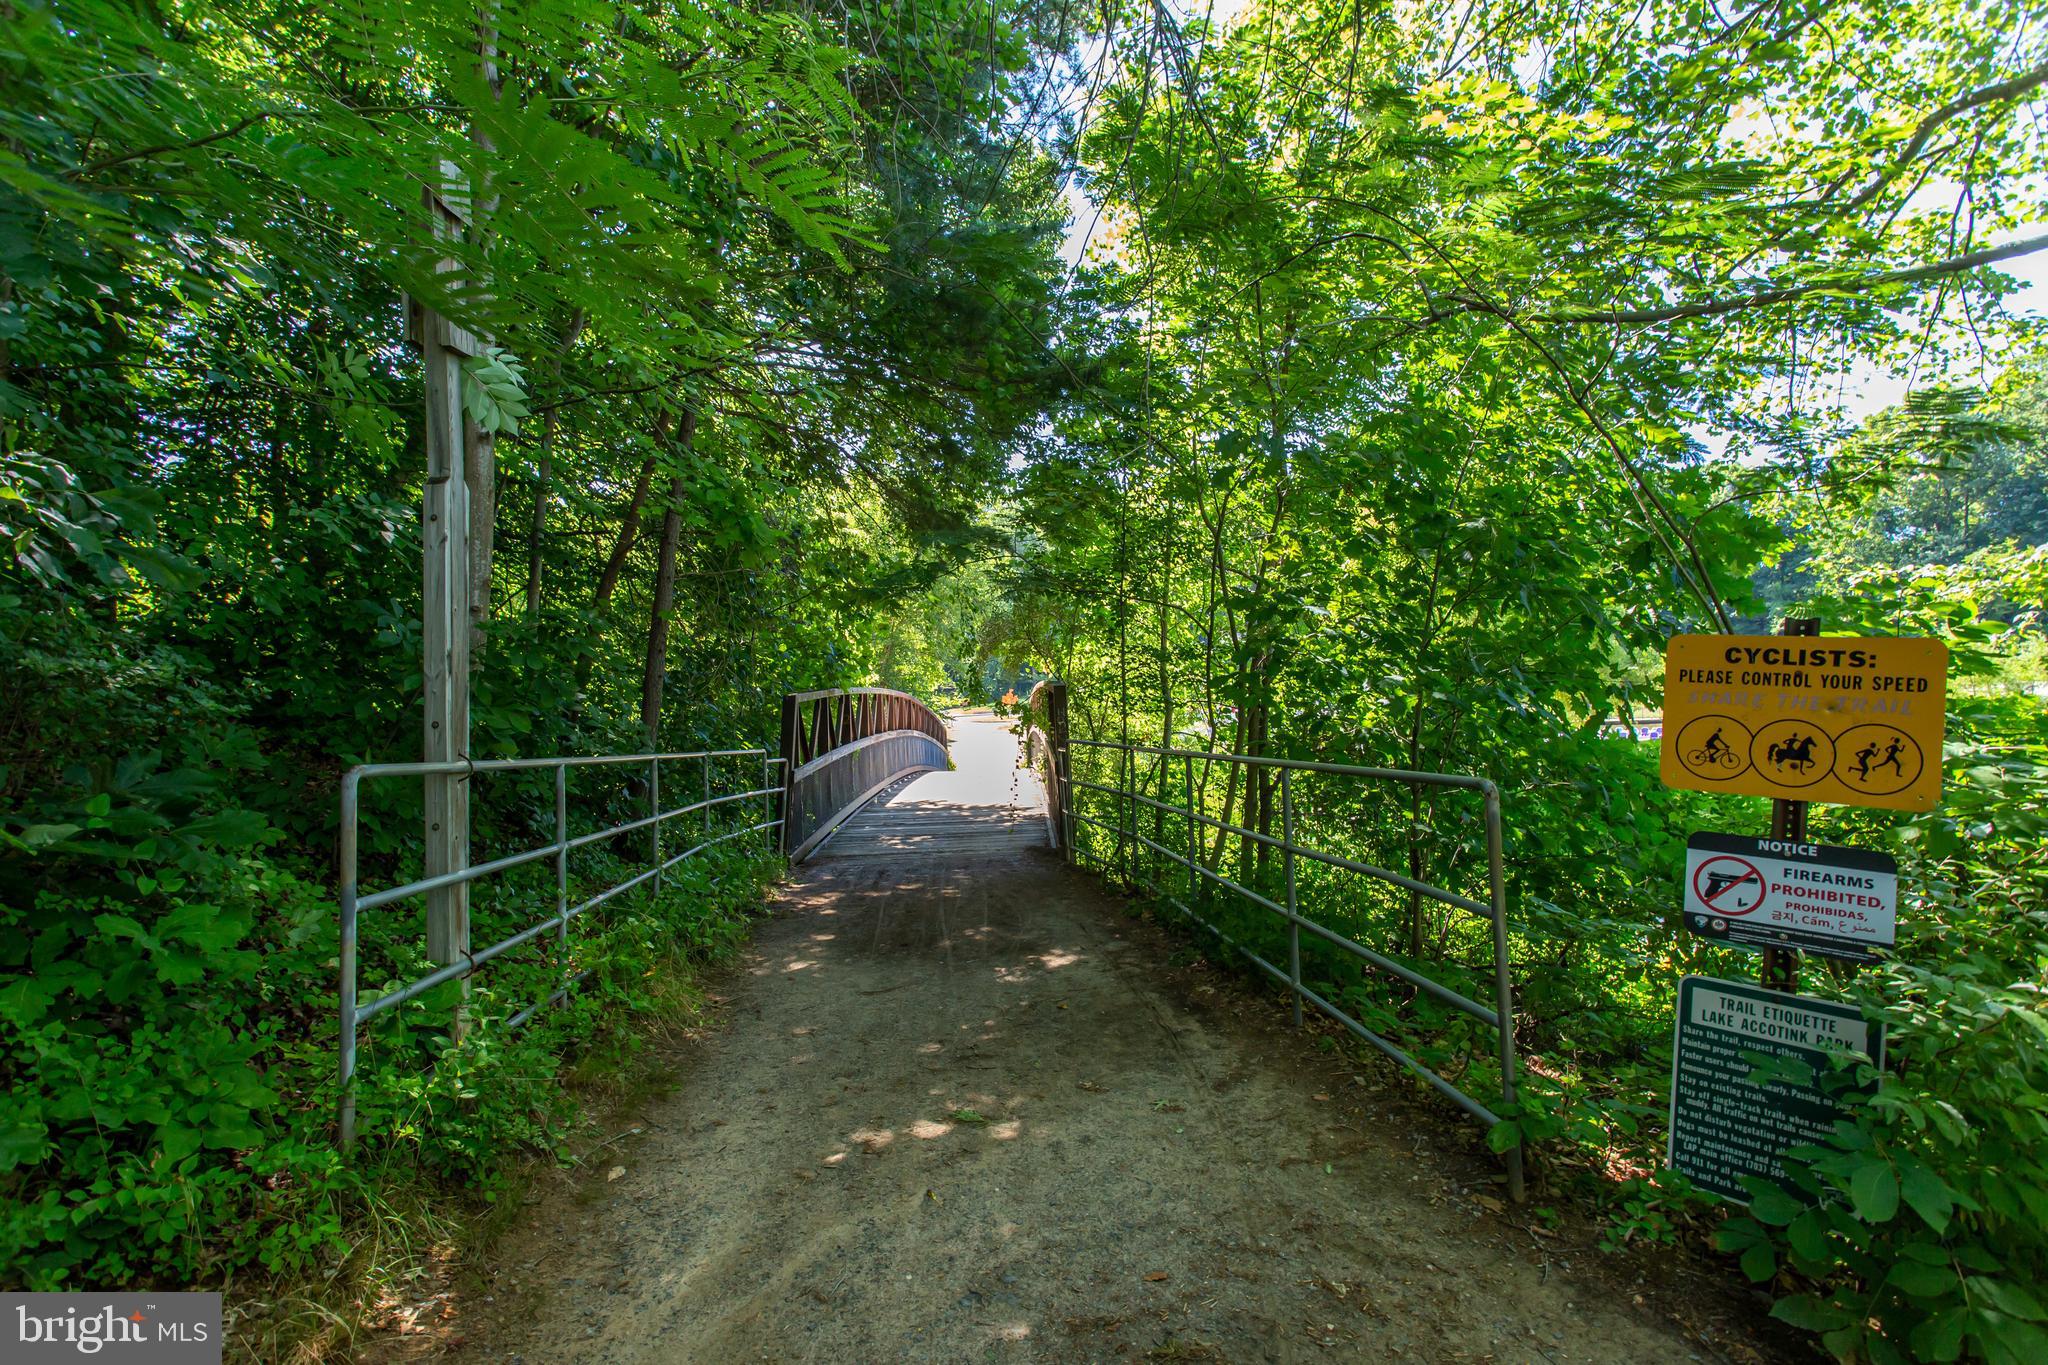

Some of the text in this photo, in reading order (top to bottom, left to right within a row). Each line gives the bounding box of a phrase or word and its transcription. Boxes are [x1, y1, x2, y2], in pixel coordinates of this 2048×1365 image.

[1725, 647, 1877, 668] CYCLISTS:
[1679, 669, 1928, 692] PLEASE CONTROL YOUR SPEED
[1687, 690, 1913, 716] SHARE THE TRAIL
[1758, 839, 1818, 857] NOTICE
[1784, 867, 1874, 889] FIREARMS
[1771, 883, 1886, 911] PROHIBITED,
[1785, 902, 1868, 921] PROHIBIDAS,
[1702, 1009, 1734, 1027] LAKE
[1741, 1018, 1808, 1044] ACCOTINK
[1720, 997, 1836, 1033] TRAIL ETIQUETTE
[1682, 1024, 1703, 1036] Share
[1706, 1031, 1718, 1040] the
[1744, 1040, 1773, 1053] respect
[1776, 1048, 1806, 1060] others.
[1682, 1037, 1711, 1050] Maintain
[1712, 1046, 1736, 1056] proper
[1681, 1049, 1703, 1061] Faster
[1705, 1056, 1724, 1066] users
[1726, 1061, 1749, 1073] should
[1680, 1073, 1696, 1085] Stay
[1711, 1083, 1742, 1097] existing
[1744, 1090, 1768, 1103] trails.
[1681, 1061, 1712, 1076] Announce
[1715, 1071, 1730, 1080] your
[1791, 1088, 1821, 1104] Passing
[1823, 1098, 1833, 1107] on
[1678, 1106, 1687, 1115] Do
[1690, 1111, 1702, 1120] not
[1704, 1114, 1732, 1128] disturb
[1734, 1123, 1775, 1141] vegetation
[1679, 1085, 1838, 1134] Stay off single-track trails when rainin
[1712, 1103, 1722, 1113] All
[1724, 1107, 1747, 1119] traffic
[1760, 1117, 1774, 1127] wet
[1776, 1121, 1796, 1133] trails
[1676, 1130, 1701, 1145] Report
[1704, 1140, 1752, 1160] maintenance
[1754, 1154, 1769, 1164] and
[1677, 1118, 1695, 1130] Dogs
[1697, 1126, 1716, 1137] must
[1719, 1130, 1728, 1139] be
[1731, 1133, 1761, 1149] leashed
[1763, 1144, 1772, 1152] at
[1675, 1151, 1689, 1162] Call
[1692, 1156, 1704, 1167] 911
[1706, 1161, 1718, 1171] for
[1720, 1167, 1730, 1175] all
[1683, 1141, 1697, 1151] LAP
[1699, 1148, 1718, 1158] main
[1720, 1154, 1743, 1166] office
[1746, 1160, 1767, 1174] (703)
[1698, 1172, 1712, 1182] and
[1714, 1175, 1732, 1189] Park
